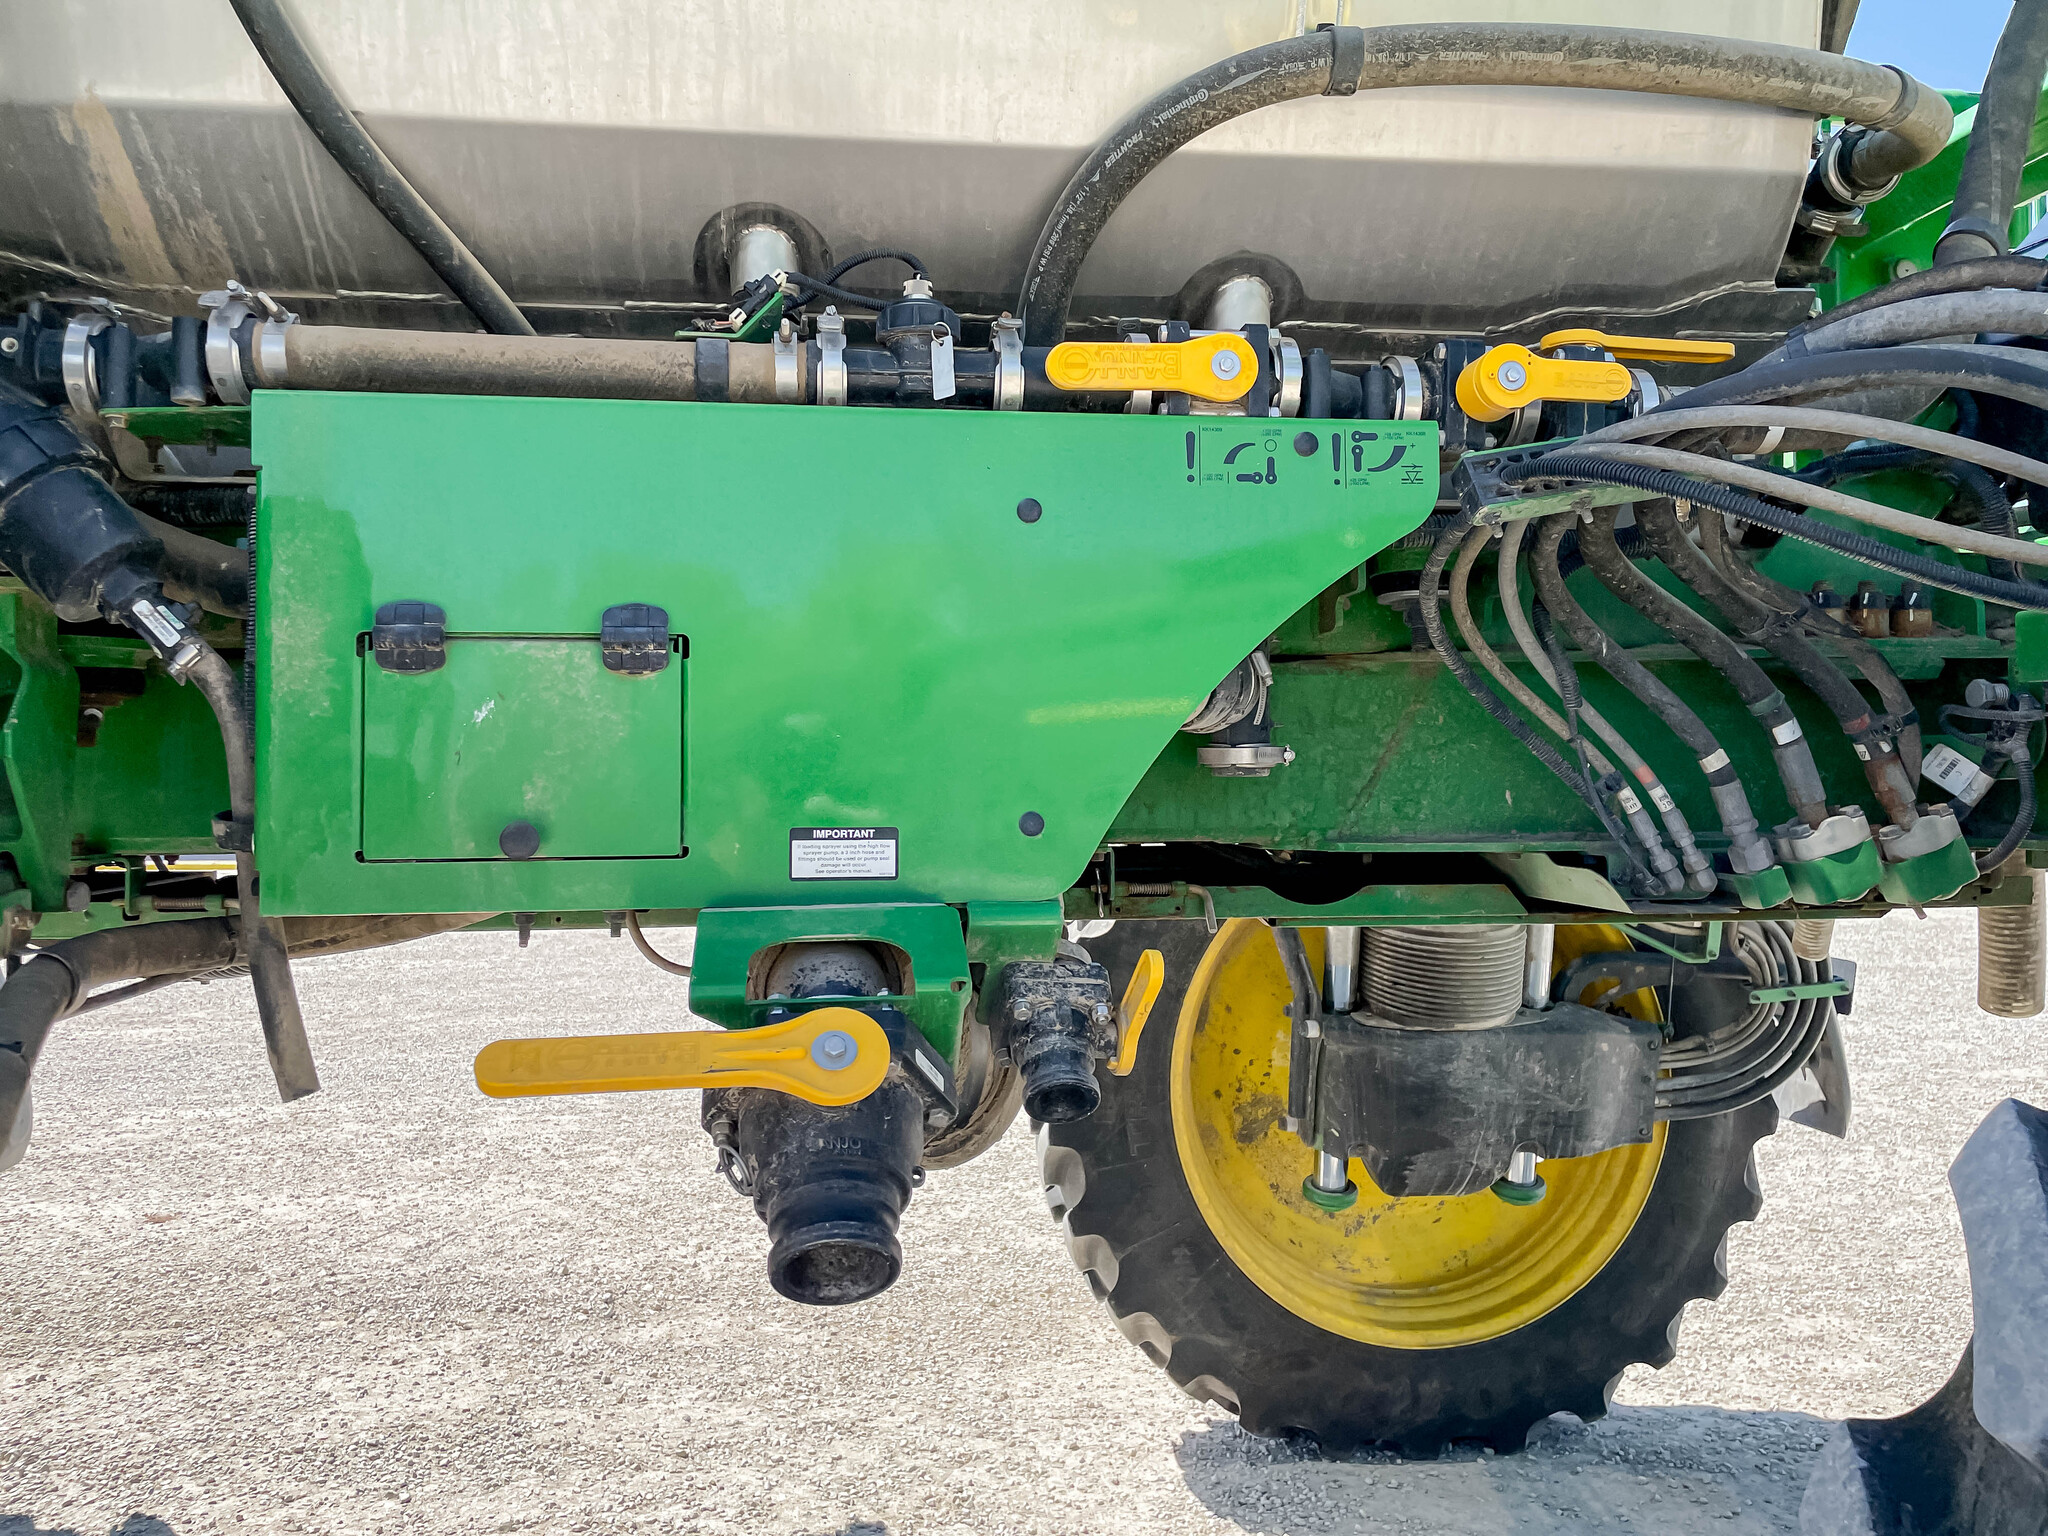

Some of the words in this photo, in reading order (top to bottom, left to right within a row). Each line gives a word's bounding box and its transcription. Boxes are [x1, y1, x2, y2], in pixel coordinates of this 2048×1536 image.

[1158, 88, 1209, 125] Continental
[1104, 129, 1144, 168] FRONTIER
[813, 829, 875, 839] IMPORTANT
